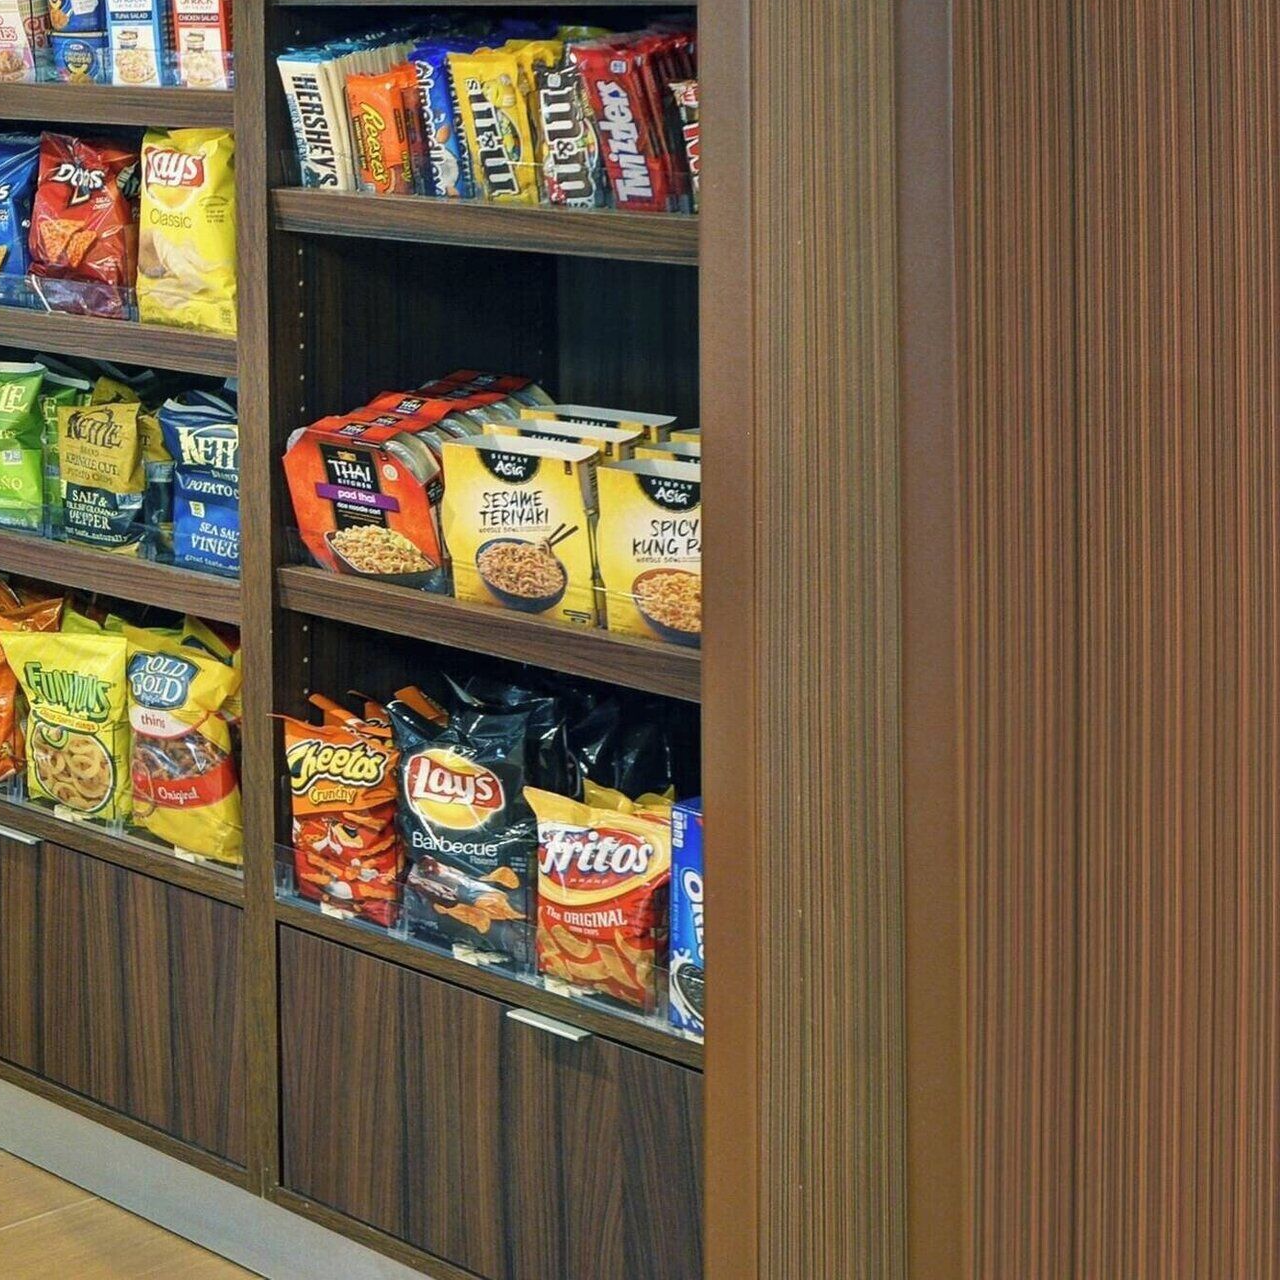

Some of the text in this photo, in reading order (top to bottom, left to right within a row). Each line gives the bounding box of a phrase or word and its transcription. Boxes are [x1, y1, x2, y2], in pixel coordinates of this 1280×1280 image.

[178, 14, 219, 22] CHICKEN SALAD
[416, 60, 443, 154] Almond
[292, 75, 338, 187] HERSHEY'S
[359, 101, 390, 184] Reese's
[596, 81, 653, 202] Twizzlers
[146, 150, 206, 188] Lay's
[149, 208, 192, 229] Classic
[65, 408, 123, 449] KETTLE
[80, 445, 100, 456] BRAND
[491, 453, 529, 464] SIMPLY
[65, 452, 97, 471] KRINKLE
[327, 459, 373, 483] THAI
[494, 462, 525, 477] Asia
[189, 478, 233, 496] POTATO
[337, 478, 372, 490] KITCHEN
[651, 479, 693, 491] SIMPLY
[72, 489, 108, 508] SALT &
[337, 490, 376, 504] pad thai
[482, 490, 544, 509] SESAME
[655, 489, 689, 505] Asia
[348, 503, 368, 513] noodle
[479, 508, 550, 527] TERIYAKI
[199, 521, 218, 536] SEA
[651, 519, 700, 538] SPICY
[632, 538, 680, 556] KUNG
[24, 661, 111, 723] FUNYUNS
[129, 672, 183, 703] GOLD
[140, 714, 166, 729] thins
[287, 740, 386, 795] Cheetos
[410, 754, 494, 805] Lay's
[157, 786, 200, 805] Original
[308, 785, 357, 804] Crunchy
[411, 831, 499, 858] Barbecue
[540, 829, 654, 874] Fritos
[545, 906, 628, 927] The ORIGINAL
[583, 928, 599, 936] CHIPS
